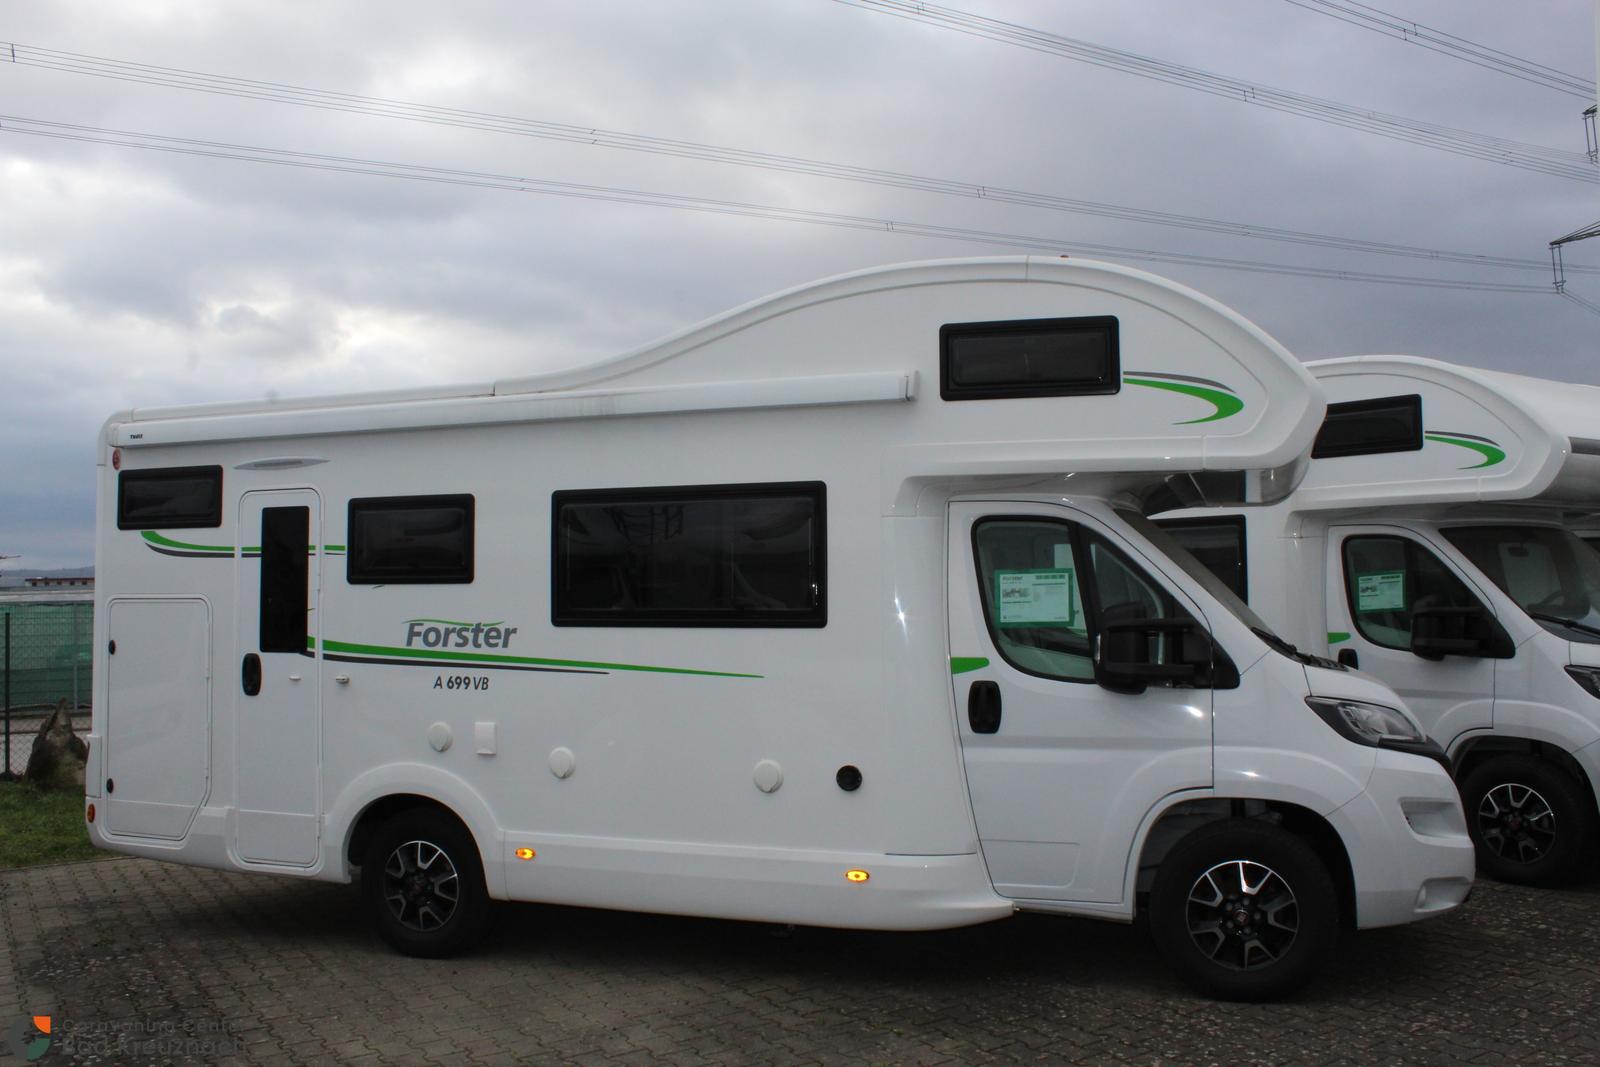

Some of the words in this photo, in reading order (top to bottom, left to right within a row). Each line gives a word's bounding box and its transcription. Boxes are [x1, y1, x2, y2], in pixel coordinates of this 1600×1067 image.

[405, 622, 518, 649] Forster
[433, 675, 443, 689] A
[446, 675, 472, 690] 699
[473, 676, 490, 690] VB
